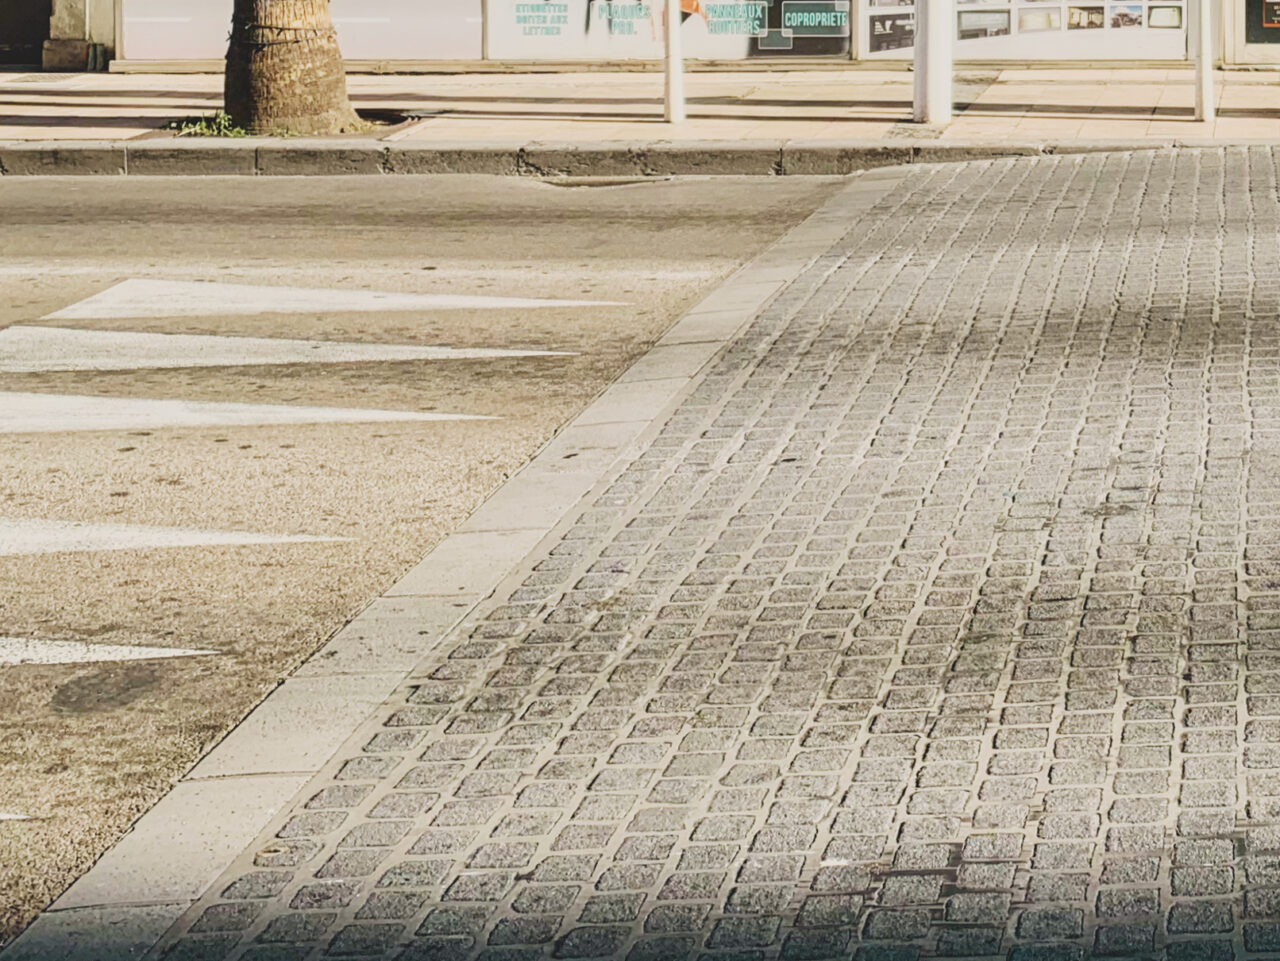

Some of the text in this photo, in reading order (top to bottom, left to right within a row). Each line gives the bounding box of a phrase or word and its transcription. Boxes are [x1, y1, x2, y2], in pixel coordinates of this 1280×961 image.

[598, 4, 650, 20] PLAQUES
[705, 4, 763, 18] PANNEAUX
[708, 19, 760, 34] ROUTIERS
[784, 12, 847, 27] COPROPRIETE
